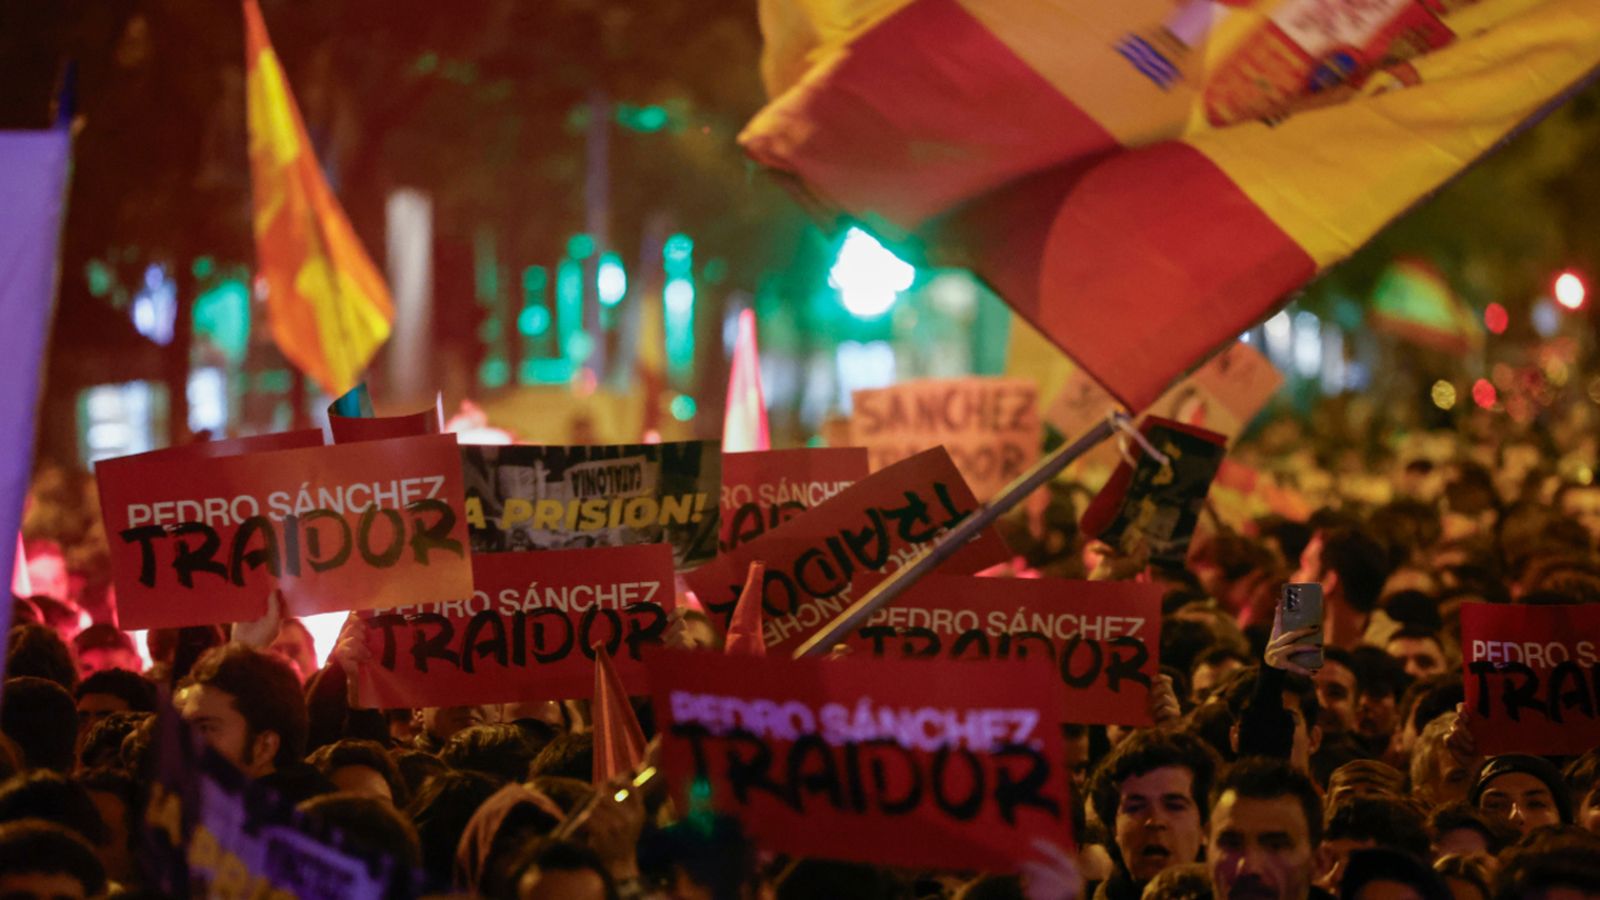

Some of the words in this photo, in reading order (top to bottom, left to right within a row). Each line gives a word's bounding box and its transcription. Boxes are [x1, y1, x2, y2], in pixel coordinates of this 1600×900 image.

[856, 382, 1037, 436] SANCHEZ
[127, 498, 259, 531] PEDRO
[267, 475, 448, 522] SÁNCHEZ
[118, 499, 465, 589] TRAIDOR
[499, 581, 662, 617] SÁNCHEZ
[867, 606, 980, 635] PEDRO
[986, 606, 1146, 642] SÁNCHEZ
[367, 601, 669, 674] TRAIDOR
[1472, 639, 1569, 668] PEDRO
[670, 690, 815, 740] PEDRO
[820, 697, 1044, 752] SÁNCHEZ
[670, 723, 1061, 826] TRAIDOR
